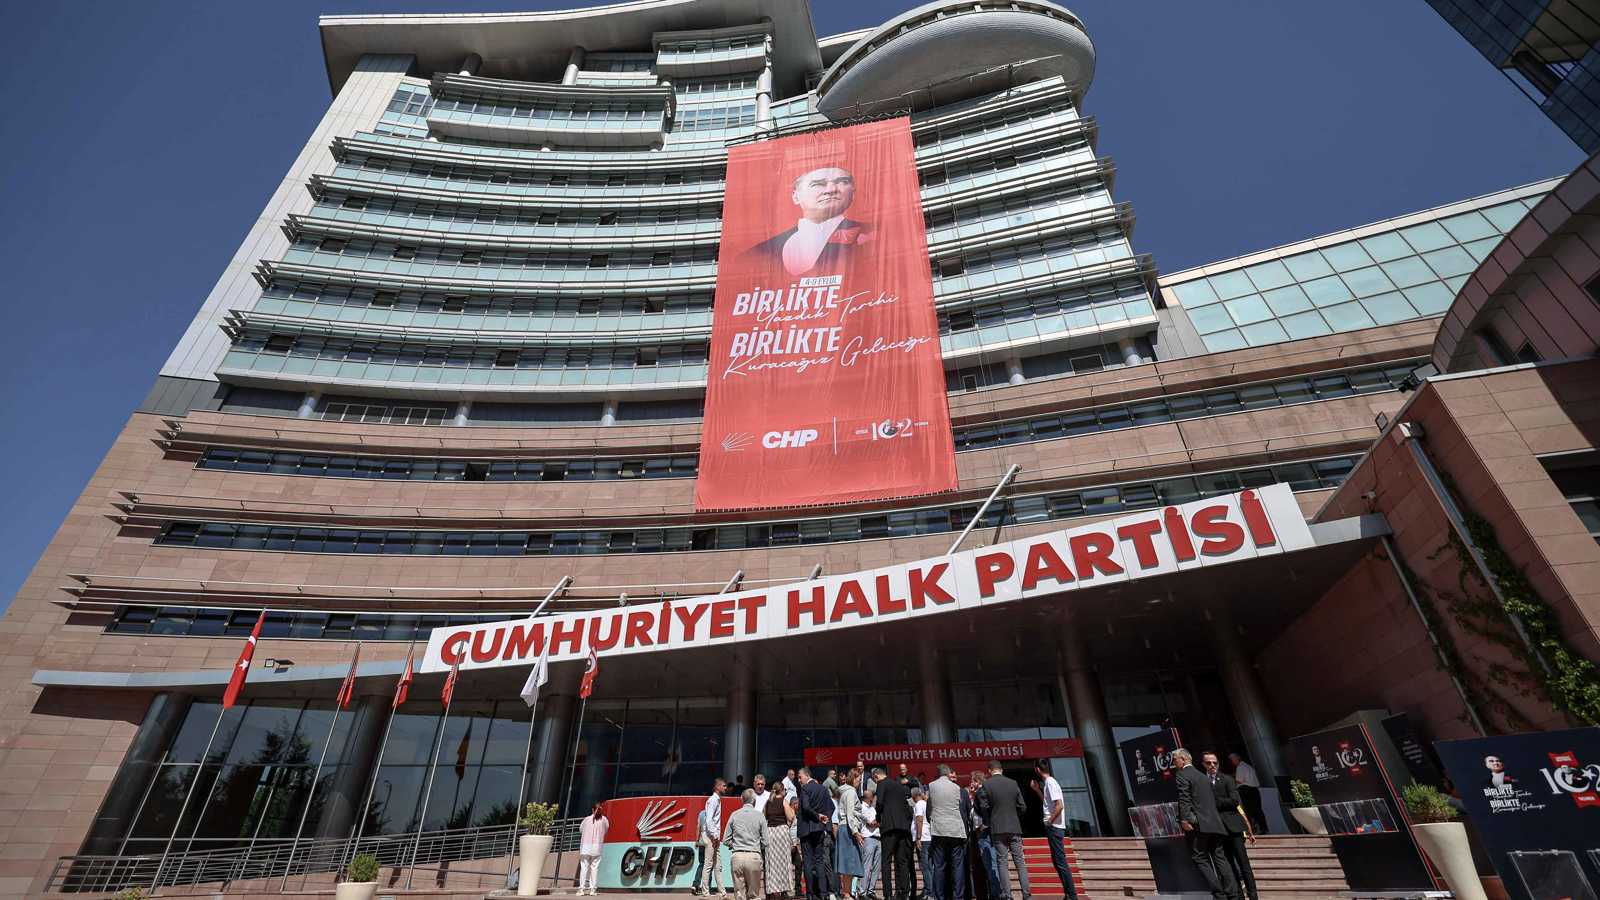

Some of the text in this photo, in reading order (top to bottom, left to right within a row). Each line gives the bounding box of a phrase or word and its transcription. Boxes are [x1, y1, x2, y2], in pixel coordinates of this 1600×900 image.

[732, 284, 841, 316] BİRLİKTE
[834, 290, 899, 322] Tarihi
[729, 325, 842, 358] BİRLİKTE
[841, 336, 931, 366] Geleceği
[762, 429, 818, 449] CHP
[439, 490, 1276, 667] CUMHURİYET HALK PARTİSİ
[858, 744, 1024, 761] CUMHURİYET HALK PARTİSİ
[621, 846, 695, 883] CHP
